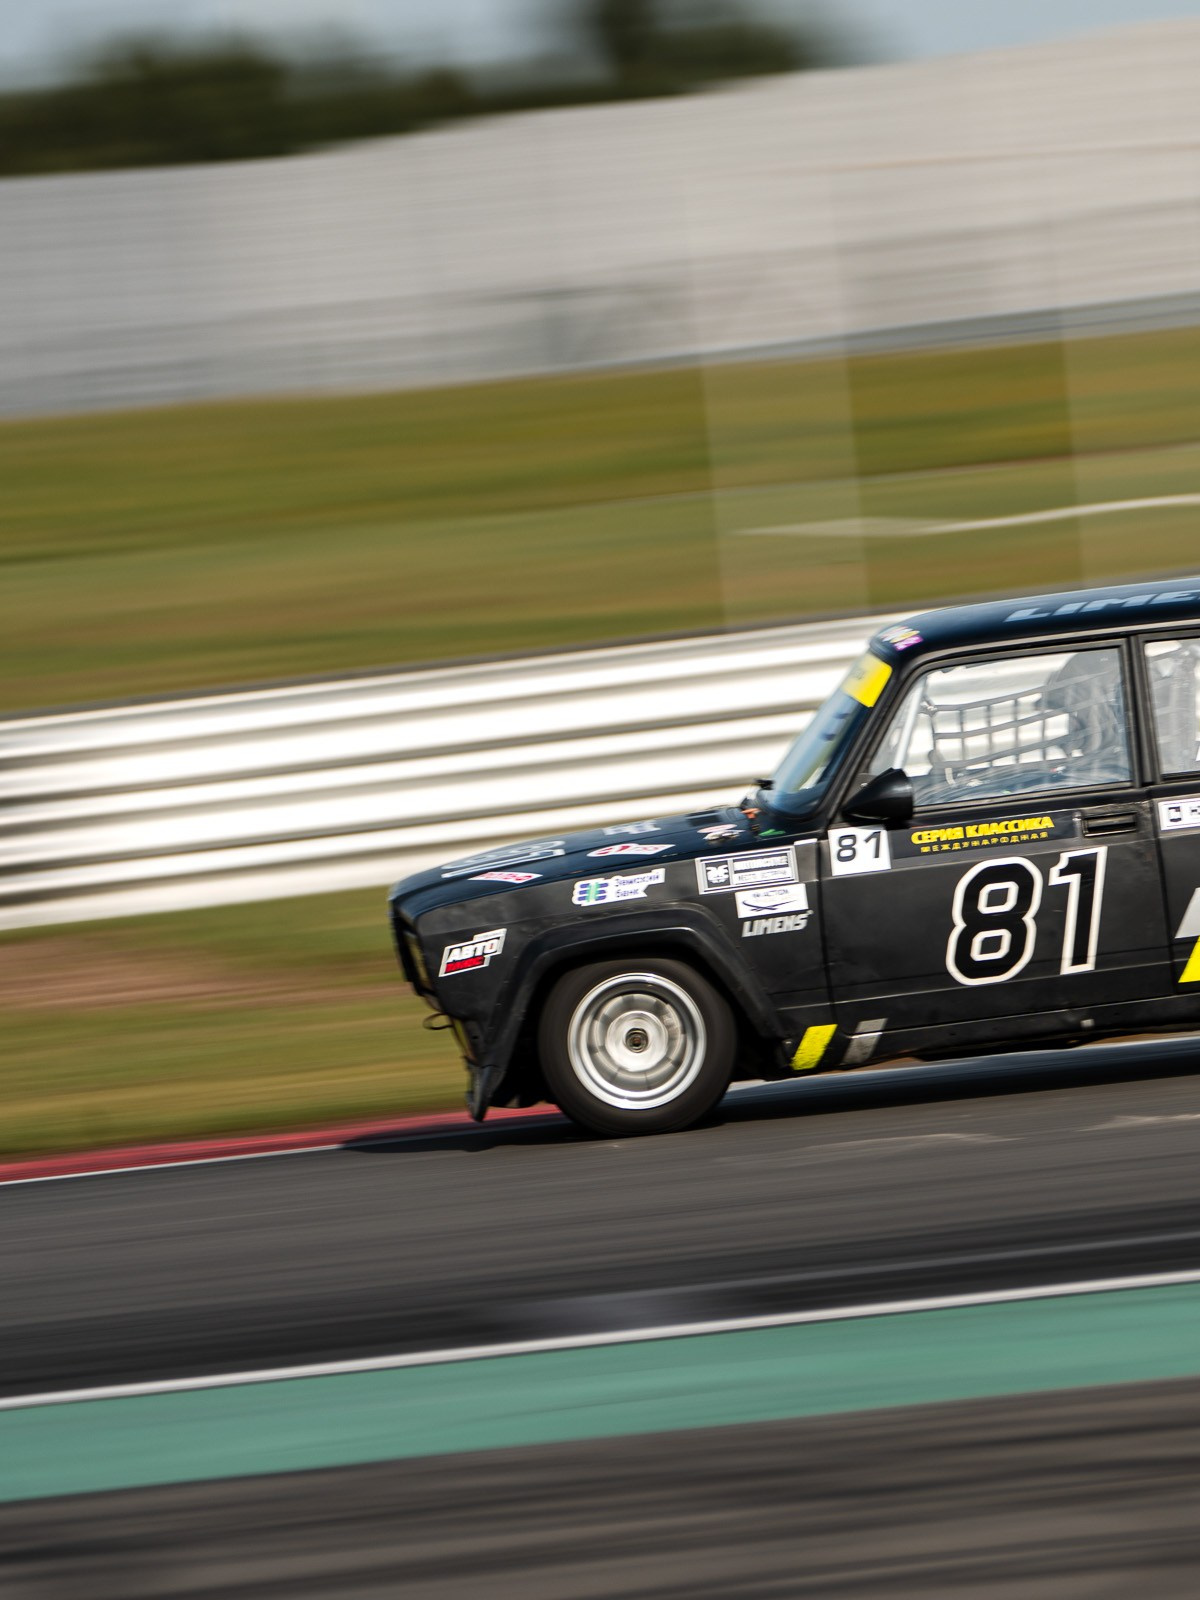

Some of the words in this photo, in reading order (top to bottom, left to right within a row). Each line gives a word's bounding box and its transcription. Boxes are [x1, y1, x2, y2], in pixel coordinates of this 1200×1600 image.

[911, 826, 964, 845] СЕРИЯ
[966, 816, 1055, 838] КЛАССИКА
[920, 831, 1049, 854] МЕЖДУНАРОДНАЯ
[837, 830, 881, 863] 81
[742, 913, 808, 938] LIMENS
[945, 846, 1107, 986] 81
[446, 939, 499, 963] АВТО
